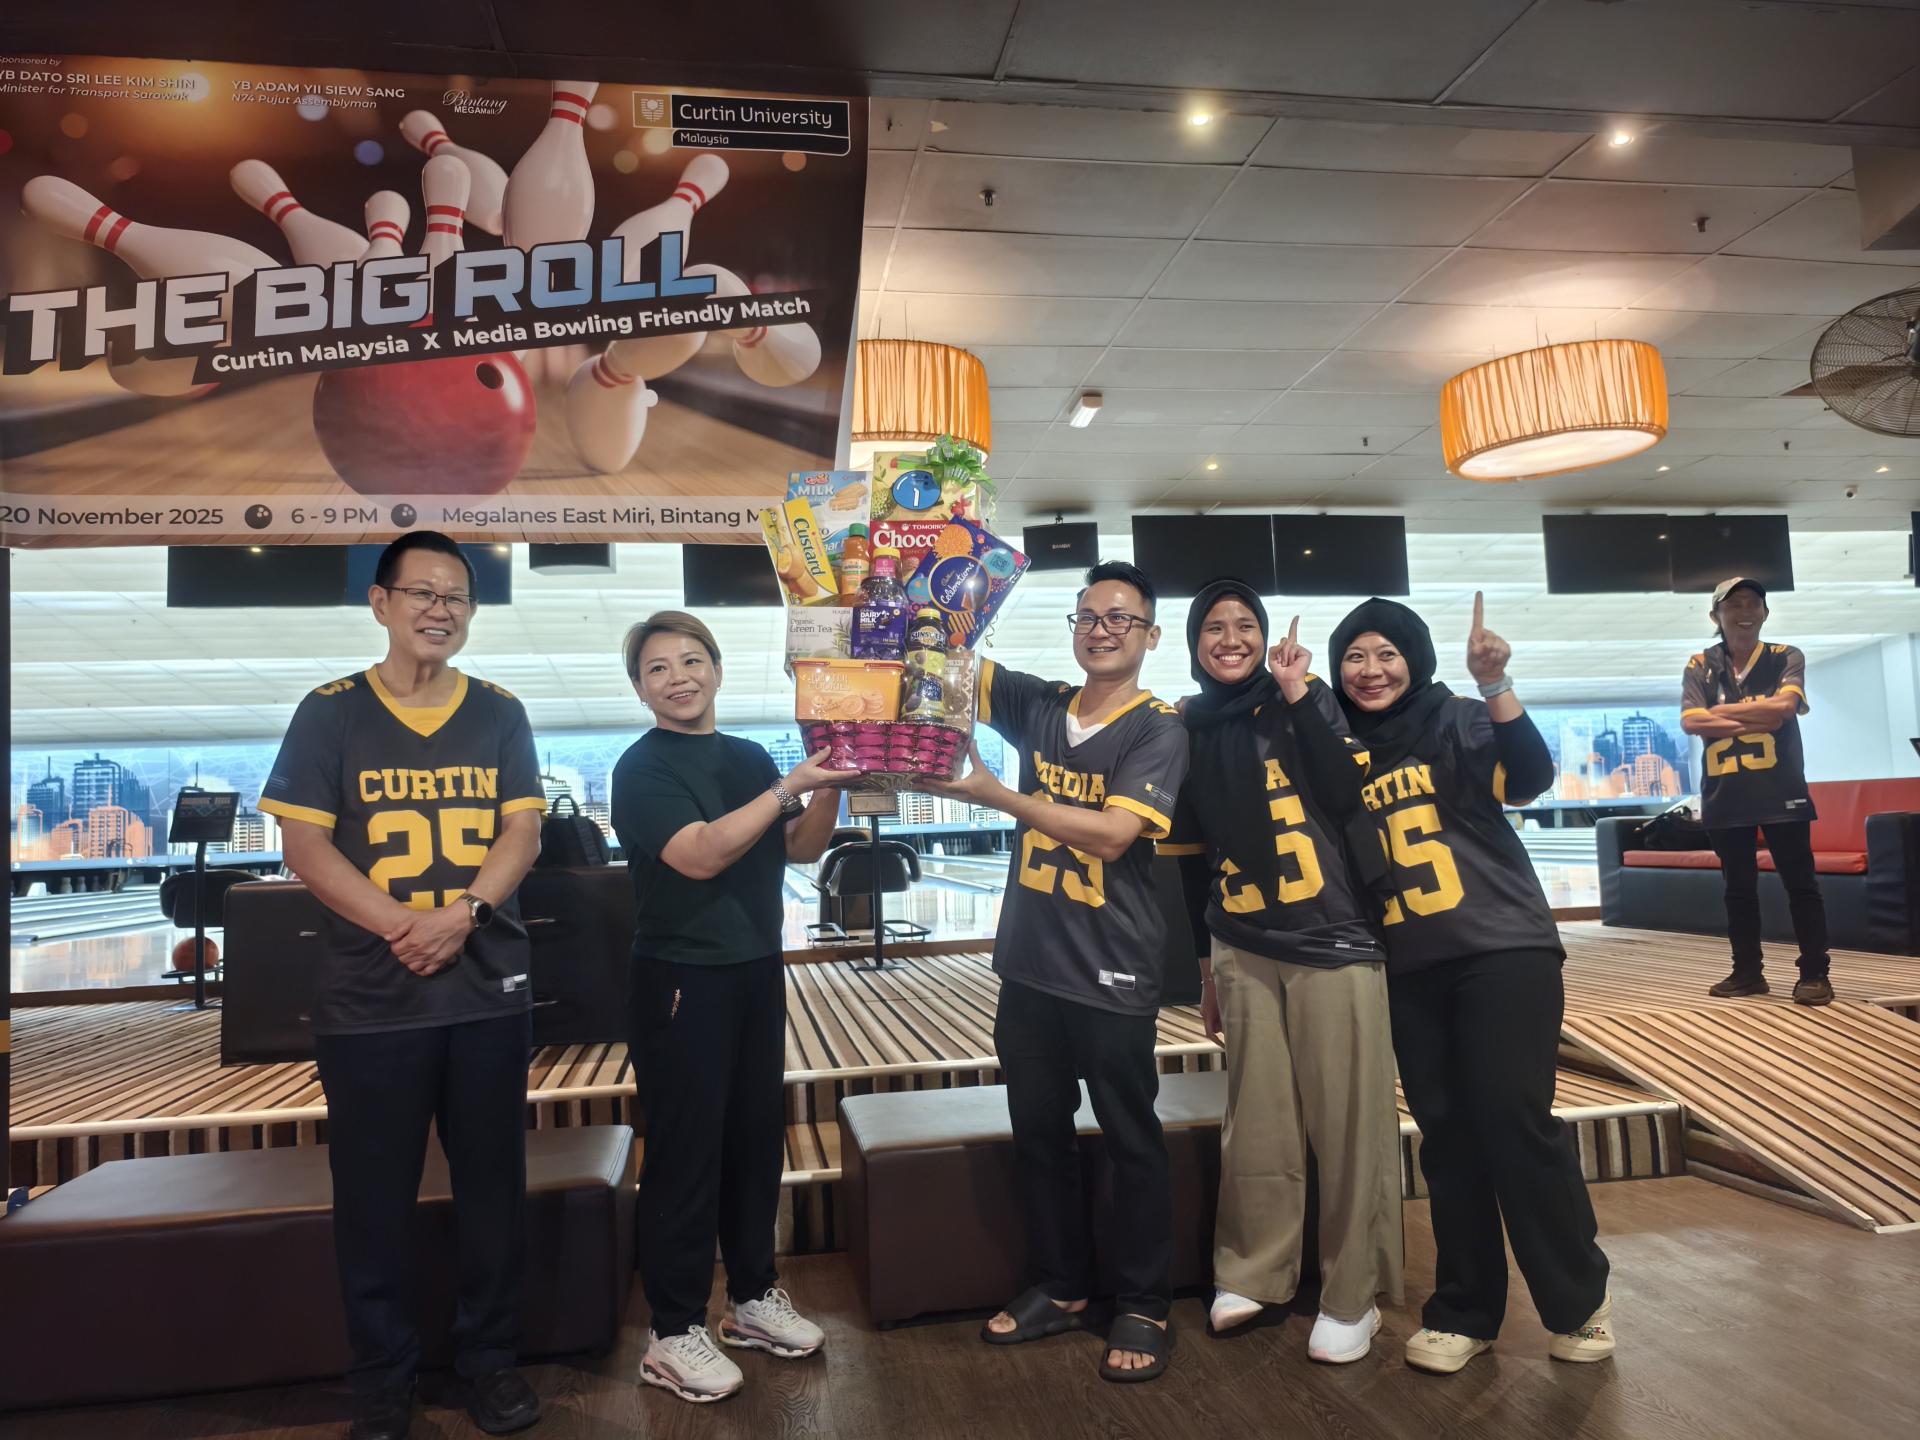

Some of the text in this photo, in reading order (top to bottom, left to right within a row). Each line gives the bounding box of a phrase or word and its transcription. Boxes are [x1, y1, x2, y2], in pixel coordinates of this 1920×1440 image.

[49, 58, 61, 67] by
[20, 71, 63, 83] DATO
[66, 73, 90, 84] SRI
[95, 75, 122, 86] LEE
[126, 76, 154, 87] KIM
[159, 78, 195, 89] SHIN
[232, 80, 406, 98] YB ADAM YII SIEW SANG
[49, 85, 66, 94] for
[70, 87, 129, 99] Transport
[133, 90, 189, 101] Sarawak
[232, 94, 378, 110] N74 Pujut Assemblyman
[442, 89, 508, 115] Bintang
[454, 105, 496, 115] MEGAMall
[679, 103, 833, 129] Curtin University
[680, 131, 730, 146] Malaysia
[9, 231, 717, 362] THE BIG ROLL
[211, 297, 811, 373] Curtin Malaysia X Media Bowling Friendly Match
[797, 484, 835, 496] MILK
[0, 507, 31, 524] 20
[37, 508, 165, 525] November
[169, 508, 224, 524] 2025
[290, 508, 305, 523] 6
[323, 508, 337, 523] 9
[343, 508, 378, 523] PM
[442, 507, 558, 526] Megalanes
[563, 508, 608, 524] East
[612, 507, 656, 526] Miri,
[660, 507, 742, 527] Bintang
[792, 517, 827, 577] Custard
[873, 529, 940, 548] Choco
[789, 624, 833, 633] Green Tea
[359, 766, 498, 802] CURTIN
[1360, 764, 1436, 812] RTIN
[367, 808, 495, 912] 25
